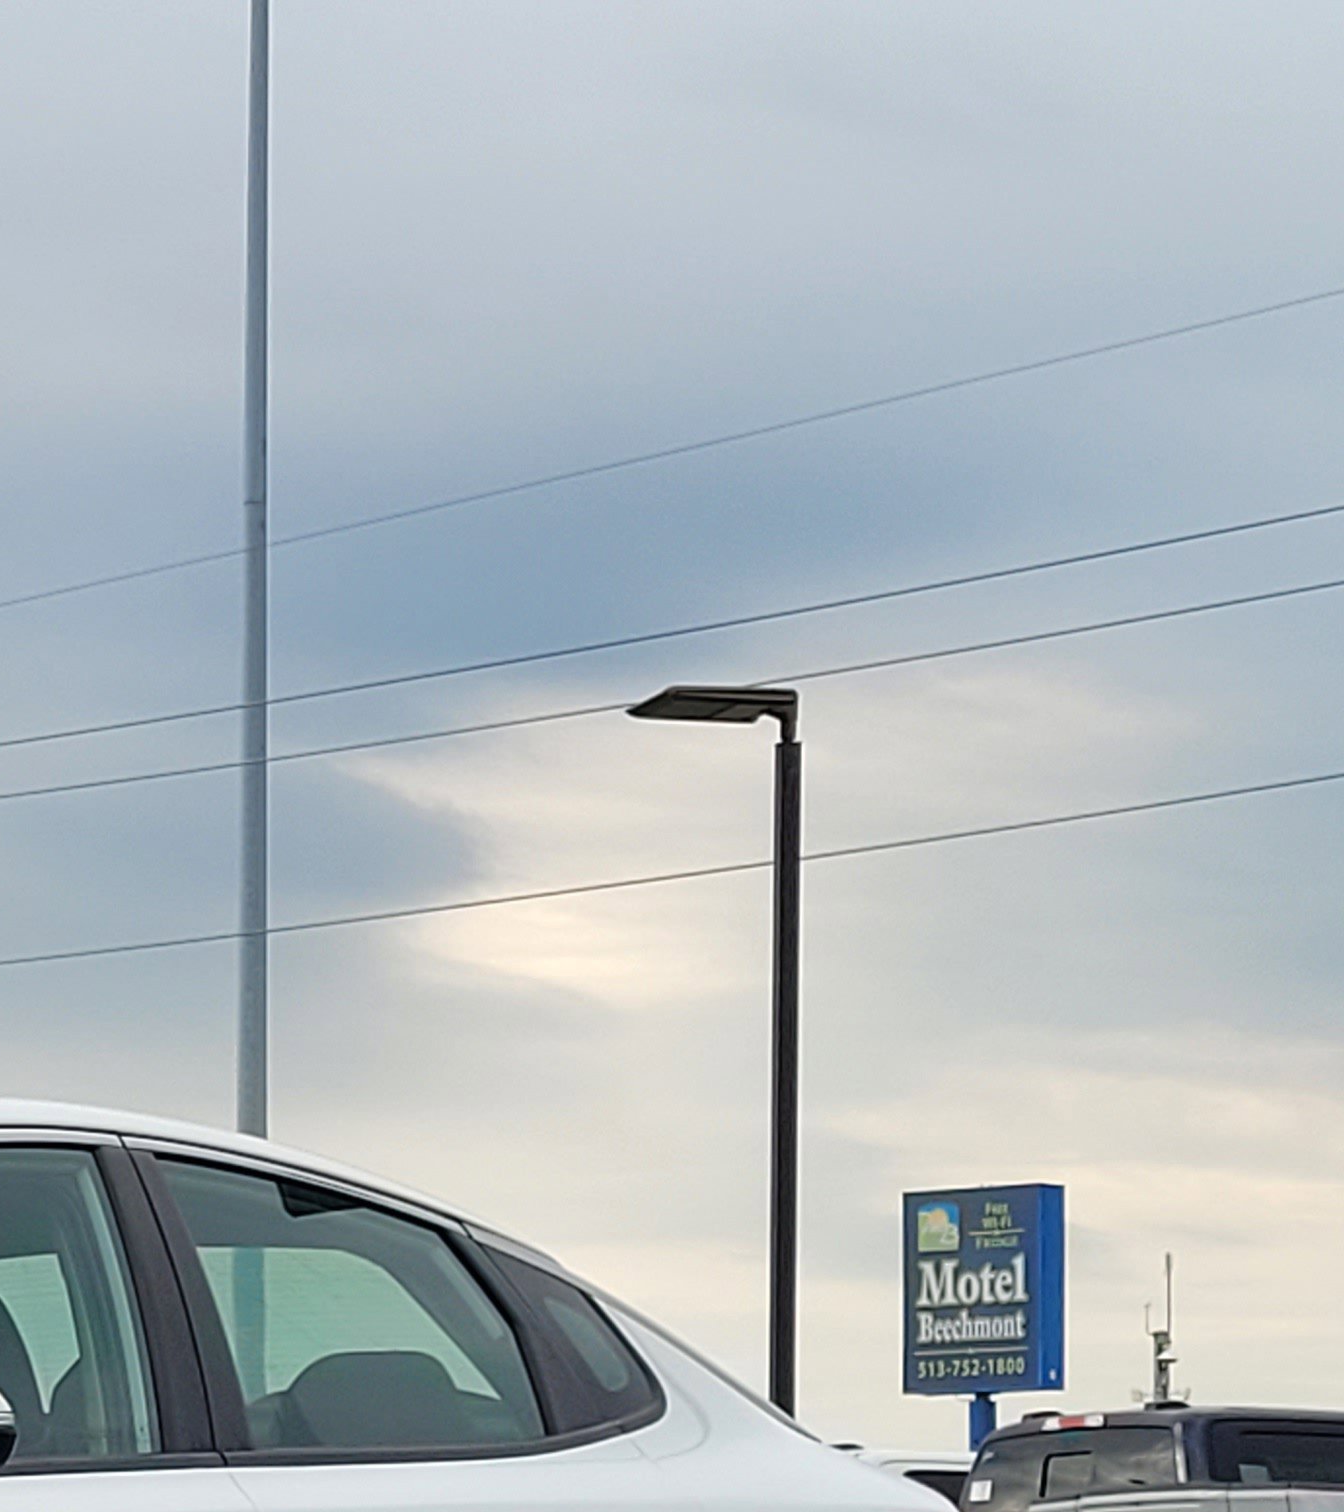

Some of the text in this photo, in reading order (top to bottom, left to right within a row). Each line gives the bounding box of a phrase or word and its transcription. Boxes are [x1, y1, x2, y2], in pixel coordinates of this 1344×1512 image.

[915, 1252, 1029, 1307] Motel
[916, 1308, 1026, 1344] Beechmont
[917, 1356, 1025, 1379] 513-752-1800
